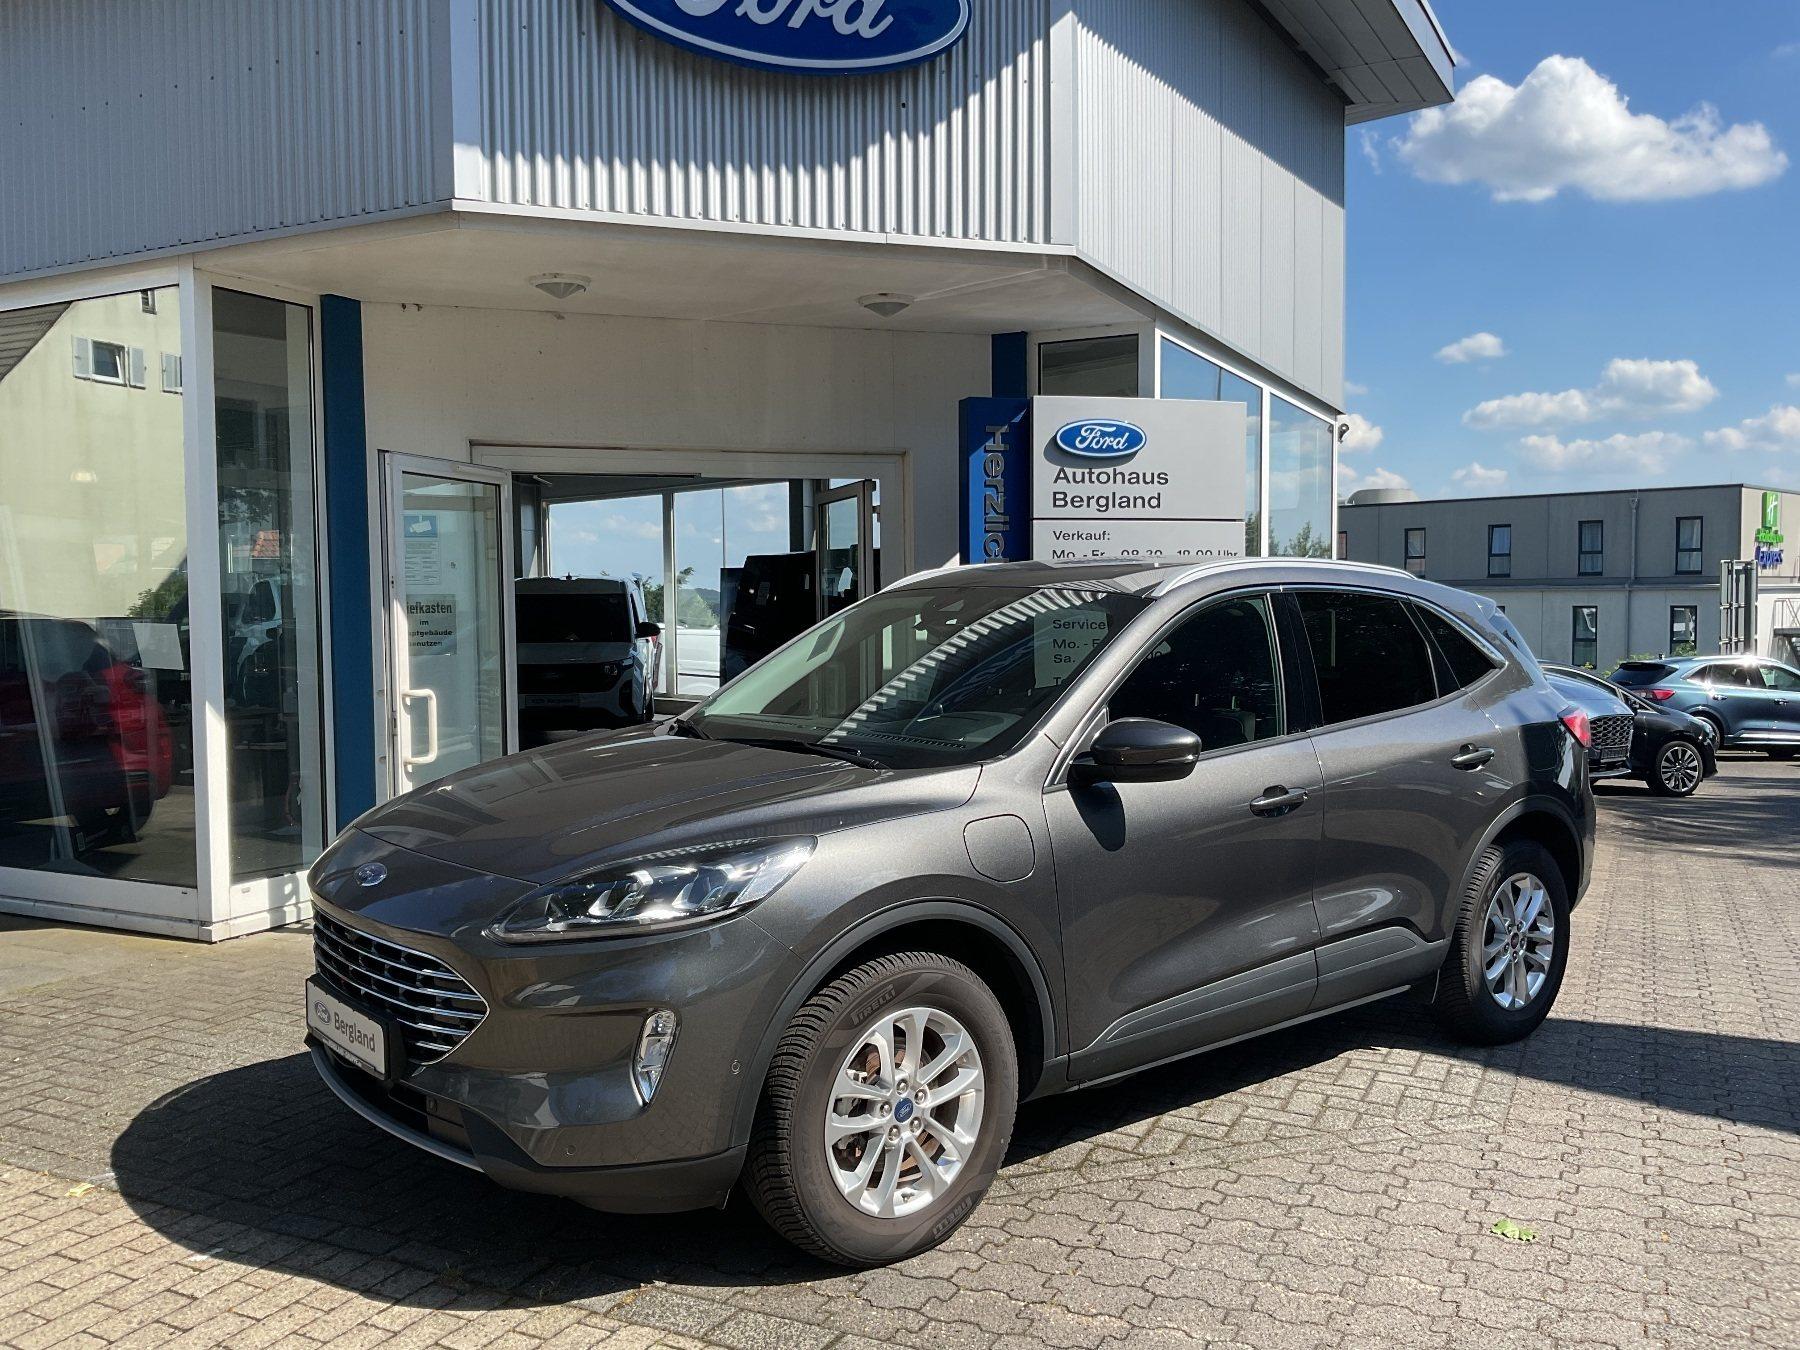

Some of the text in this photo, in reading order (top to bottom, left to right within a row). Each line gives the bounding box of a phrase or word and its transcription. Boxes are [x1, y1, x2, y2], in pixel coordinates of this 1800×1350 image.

[674, 0, 894, 39] ord
[1075, 425, 1128, 449] Ford
[1053, 467, 1169, 485] Autohaus
[1053, 491, 1161, 512] Bergland
[1053, 531, 1111, 541] Verkauf:
[1052, 549, 1076, 559] Mo
[407, 602, 453, 614] iefkasten
[1052, 619, 1107, 630] Service
[1053, 639, 1080, 649] Mo.
[1053, 653, 1076, 664] Sa.
[334, 1012, 376, 1053] Bergland
